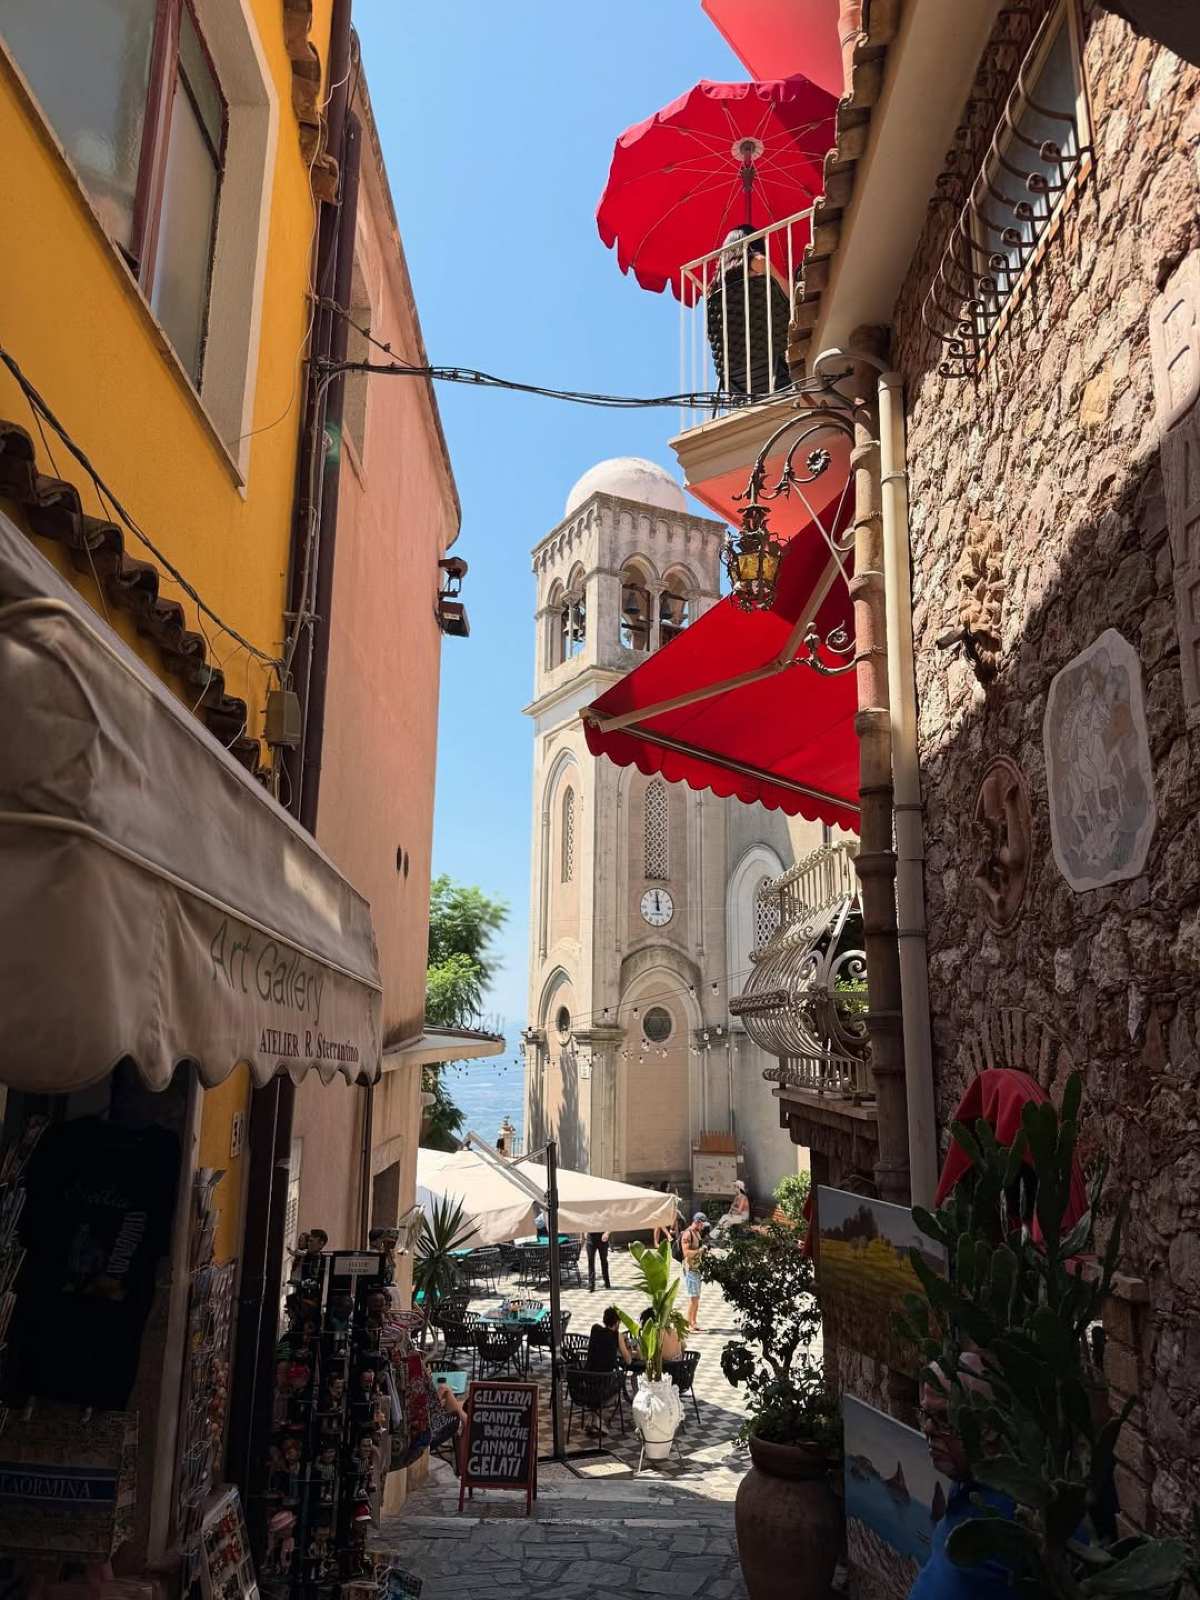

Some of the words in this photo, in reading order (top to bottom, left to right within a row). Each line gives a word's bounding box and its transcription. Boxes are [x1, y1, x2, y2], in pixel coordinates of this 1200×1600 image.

[210, 919, 251, 994] Art
[256, 941, 324, 1026] Gallery
[259, 1028, 300, 1057] ATELIER
[305, 1030, 313, 1057] R
[474, 1390, 532, 1406] GELATERIA
[473, 1411, 522, 1427] GRANITE
[484, 1425, 529, 1440] BRIOCHE
[471, 1440, 528, 1457] CANNOLI
[468, 1456, 522, 1477] GELATI
